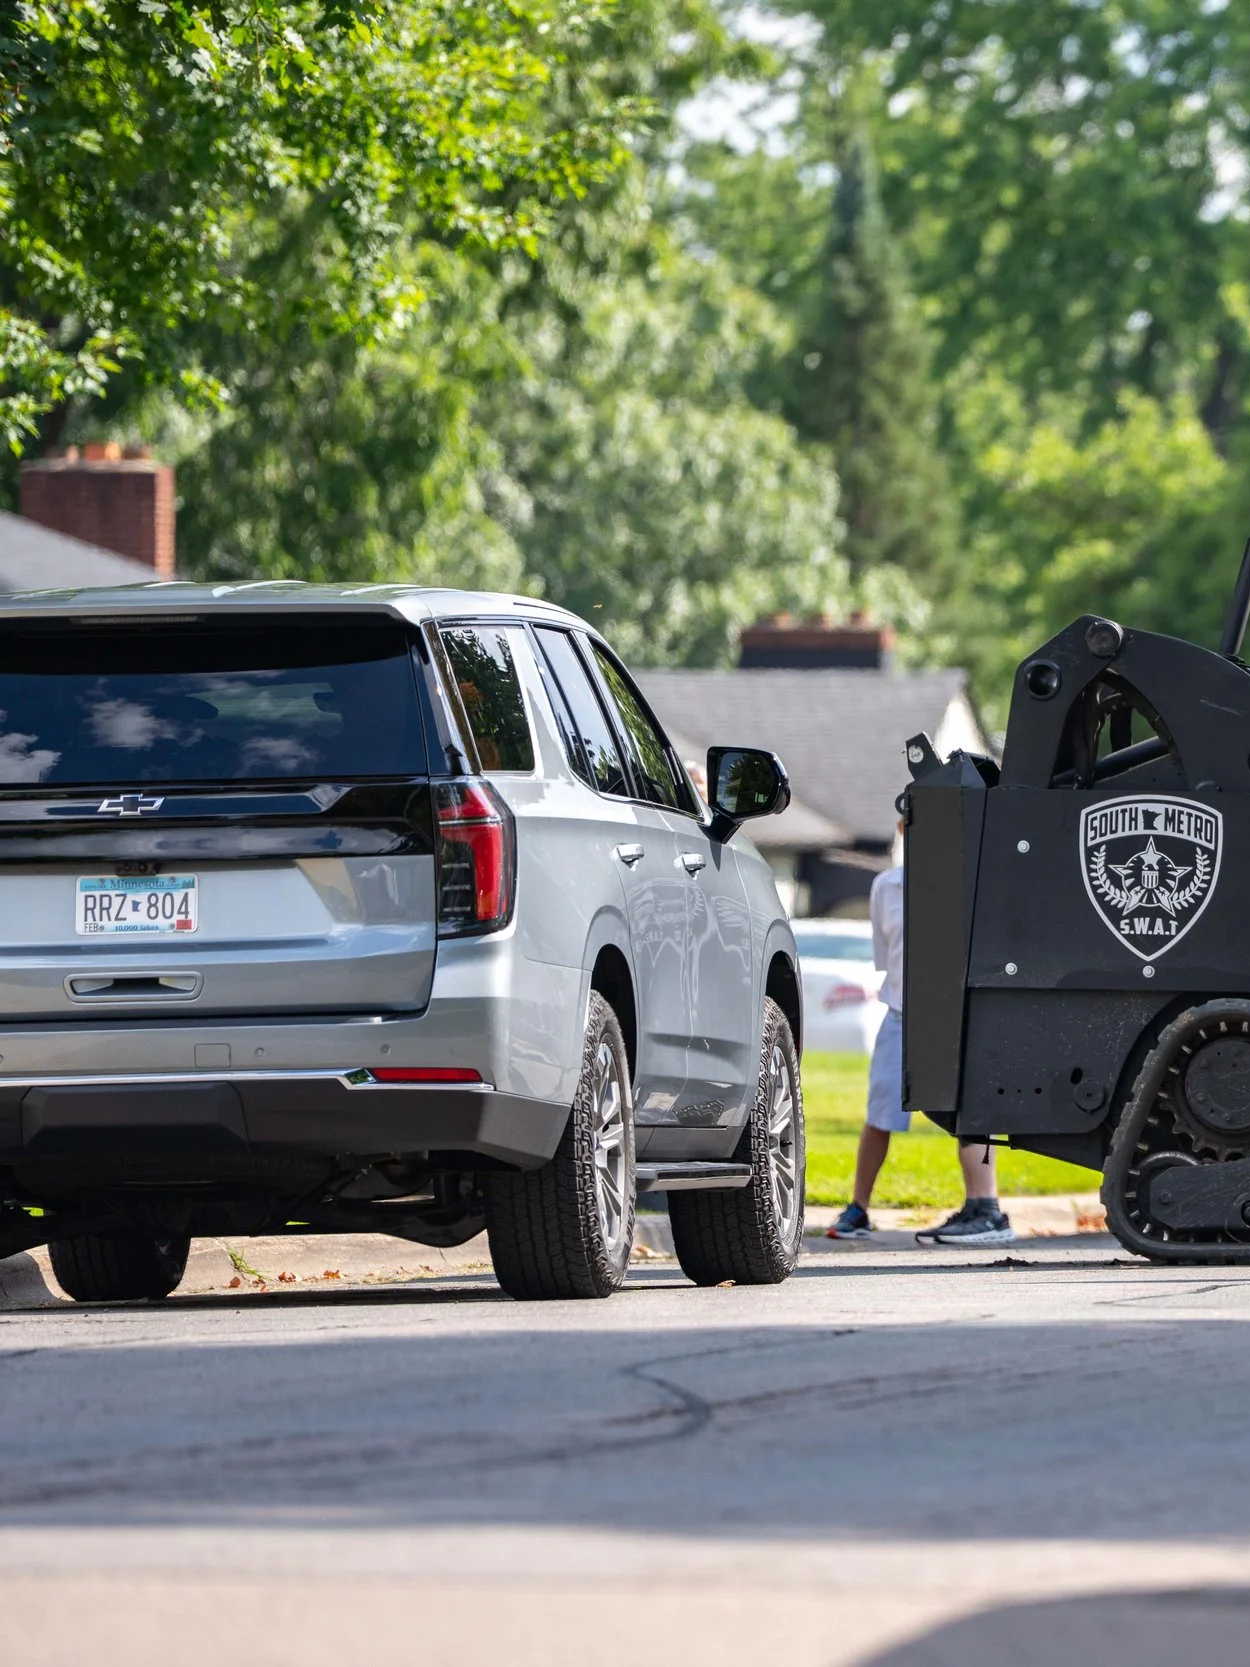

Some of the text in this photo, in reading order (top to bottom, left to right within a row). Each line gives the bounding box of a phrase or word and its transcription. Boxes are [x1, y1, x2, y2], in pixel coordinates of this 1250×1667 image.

[1089, 806, 1214, 845] SOUTH METRO
[110, 879, 165, 889] Minnesota
[84, 891, 190, 922] RRZ 804
[84, 923, 99, 932] FEB
[1120, 917, 1179, 936] S.W.A.T
